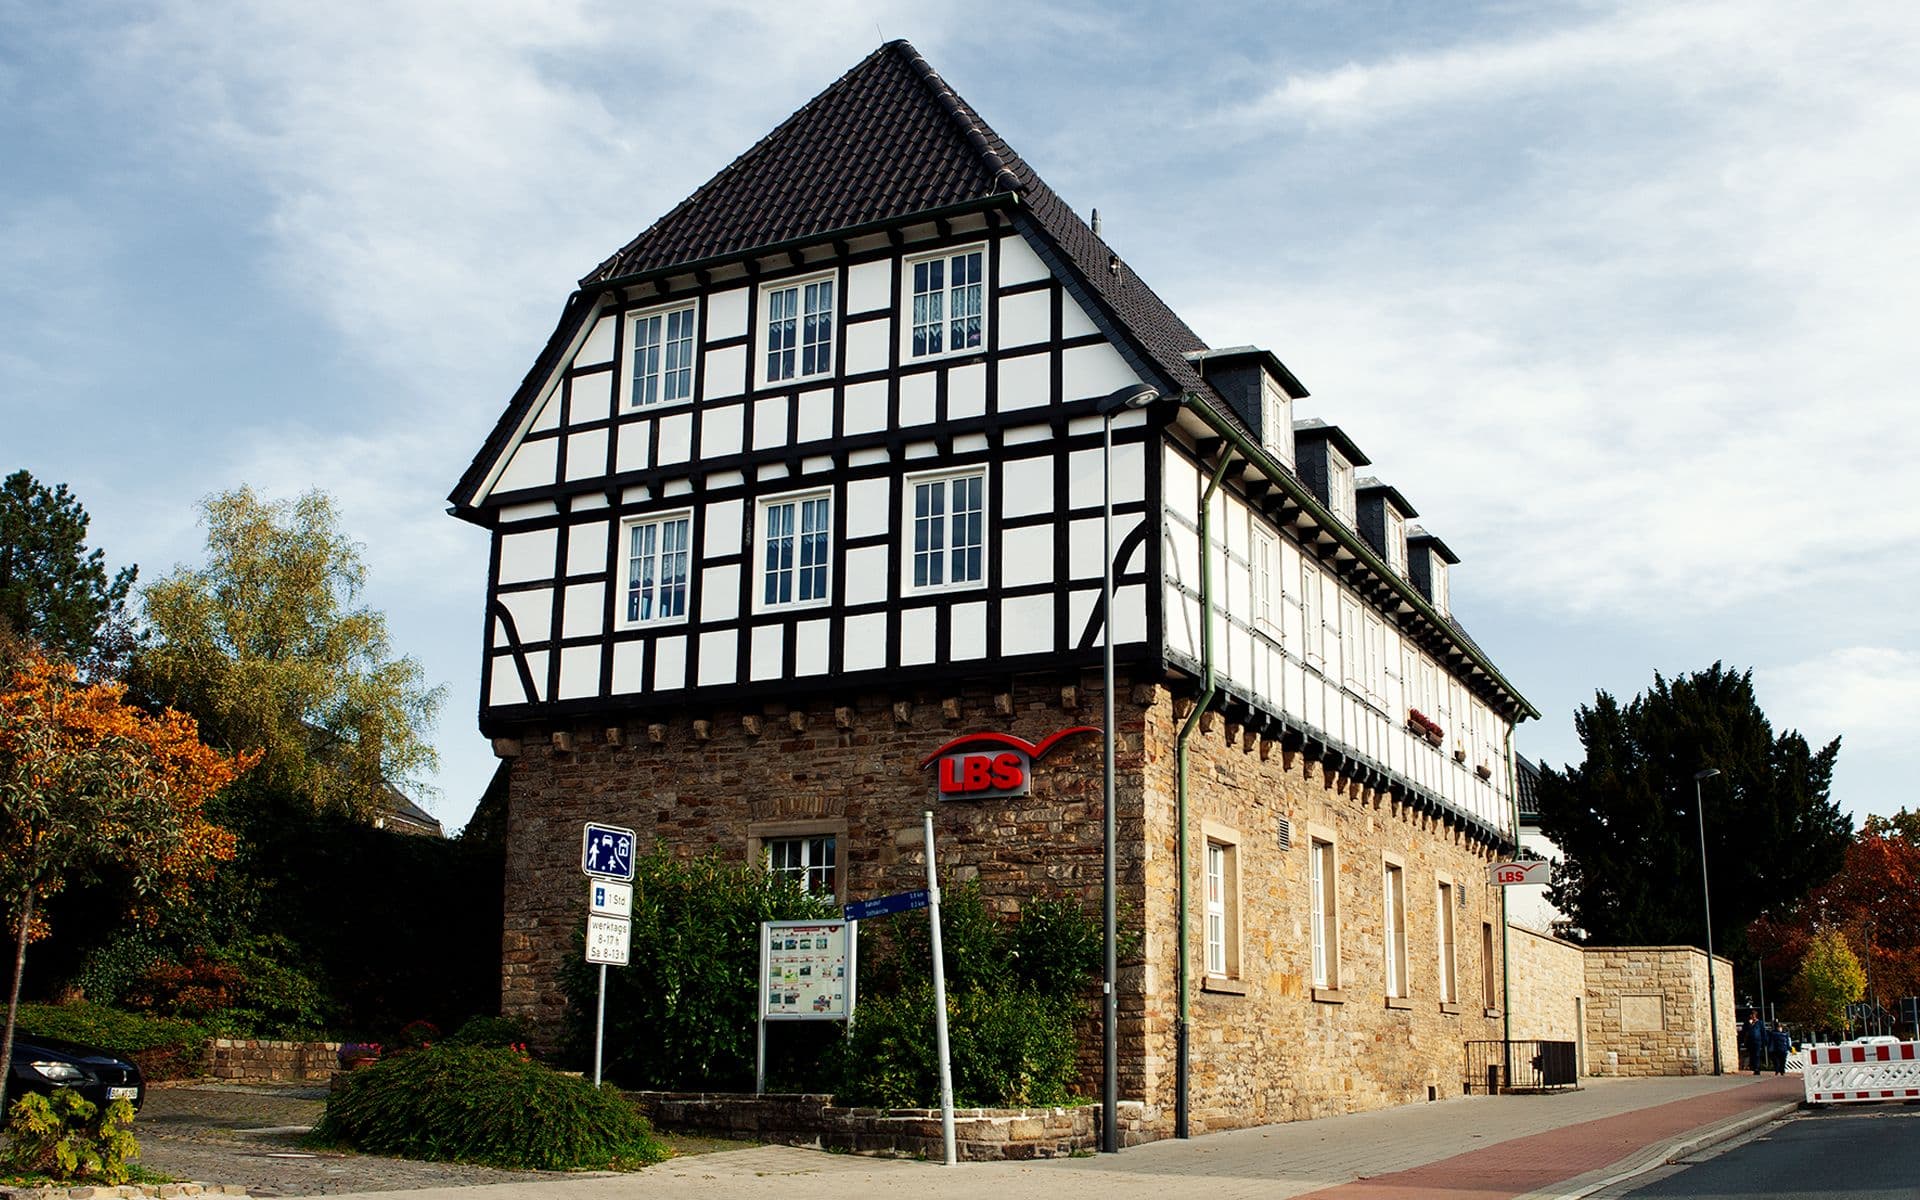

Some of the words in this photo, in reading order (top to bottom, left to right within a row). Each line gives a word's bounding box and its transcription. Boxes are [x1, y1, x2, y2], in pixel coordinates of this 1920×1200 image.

[940, 753, 1024, 793] LBS
[1497, 871, 1525, 883] LBS
[592, 921, 627, 936] werktags
